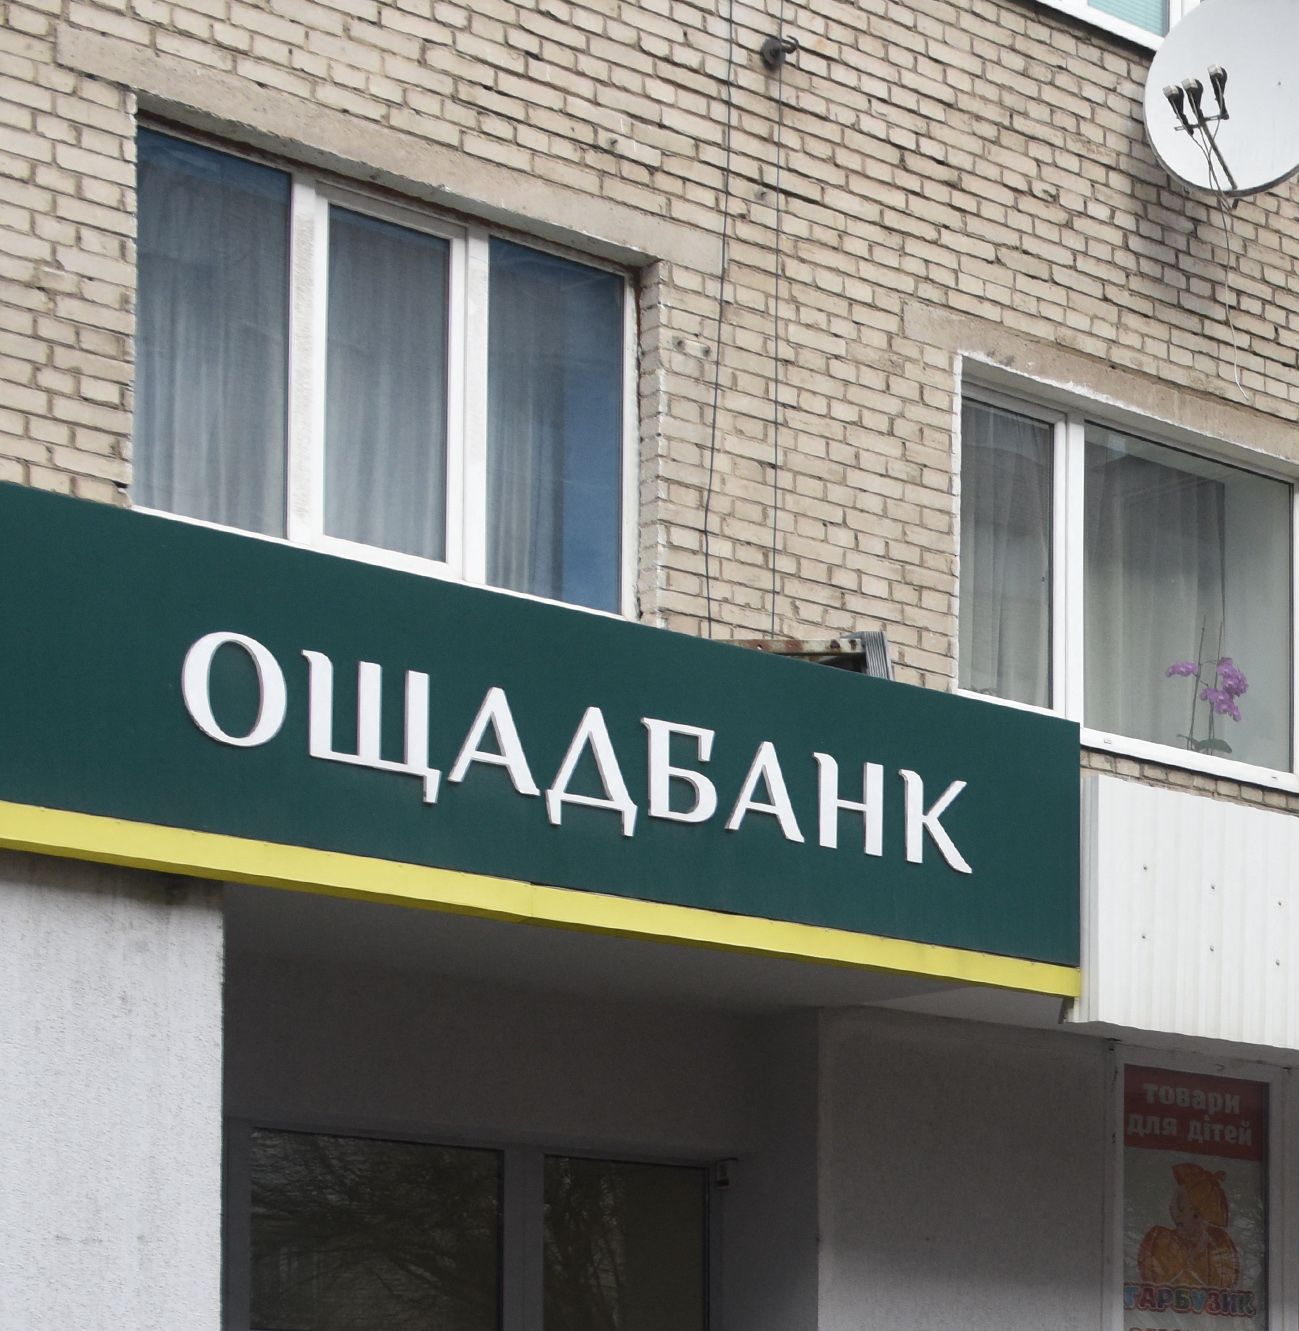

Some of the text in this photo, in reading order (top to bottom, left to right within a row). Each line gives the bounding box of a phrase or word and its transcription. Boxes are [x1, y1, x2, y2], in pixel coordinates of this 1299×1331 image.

[180, 631, 973, 875] ОЩАДБАНК
[1143, 1082, 1241, 1116] товари
[1126, 1113, 1253, 1147] для дітей
